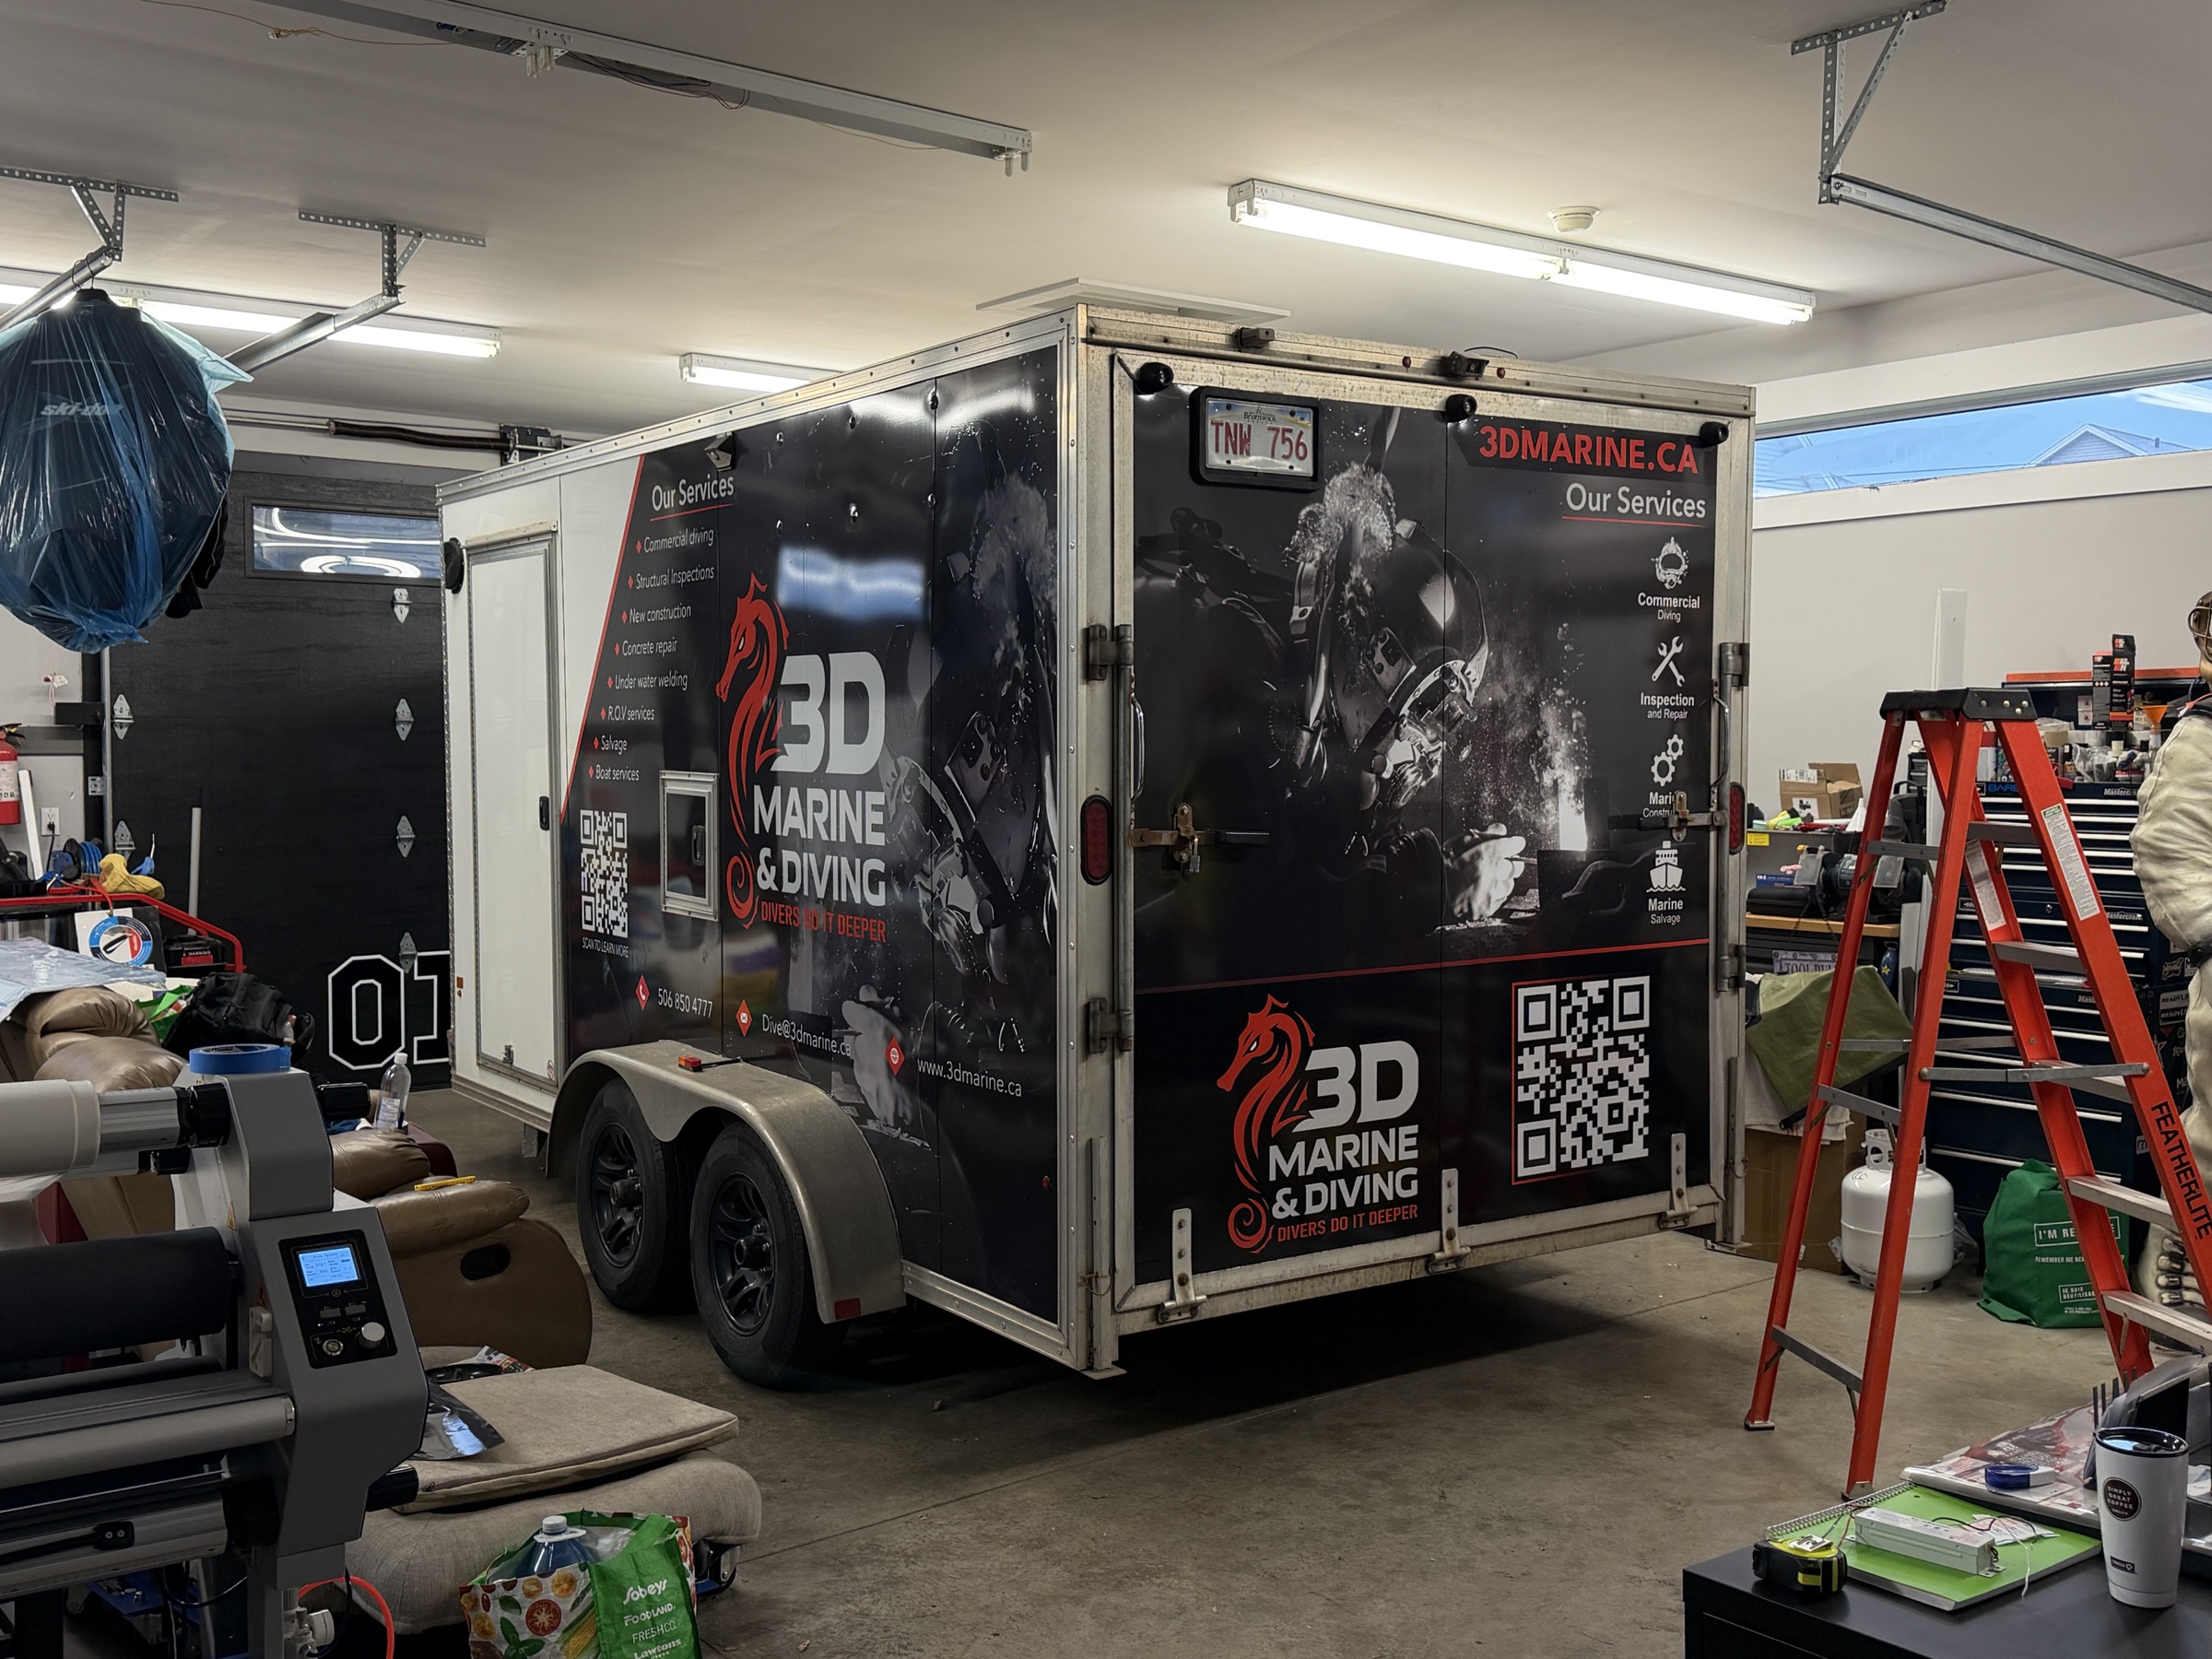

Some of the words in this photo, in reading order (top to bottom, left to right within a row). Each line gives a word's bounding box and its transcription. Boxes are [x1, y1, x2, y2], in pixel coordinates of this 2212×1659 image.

[1243, 411, 1277, 423] Brunswick
[1210, 419, 1252, 457] TNW
[1267, 425, 1308, 461] 756
[1479, 425, 1699, 474] 3DMARINE.CA
[653, 485, 676, 512] Our
[678, 474, 735, 506] Services
[1566, 483, 1610, 515] Our
[1617, 486, 1706, 519] Services
[644, 528, 688, 553] Commercial
[689, 527, 714, 547] diving
[636, 569, 669, 589] Structural
[671, 565, 714, 587] Inspections
[1638, 592, 1700, 609] Commercial
[629, 607, 646, 624] New
[646, 603, 691, 622] construction
[1657, 609, 1681, 623] Diving
[622, 640, 653, 656] Concrete
[655, 637, 677, 657] repair
[615, 674, 636, 689] Under
[637, 676, 657, 688] water
[658, 670, 688, 690] welding
[1641, 692, 1695, 708] Inspection
[608, 706, 627, 721] R.O.V
[627, 705, 654, 721] services
[771, 652, 886, 774] 3D
[1647, 709, 1662, 719] and
[1664, 708, 1688, 721] Repair
[601, 735, 628, 755] Salvage
[595, 764, 611, 781] Boat
[613, 766, 640, 781] services
[1649, 792, 1675, 805] Mari
[753, 784, 886, 846] MARINE
[757, 847, 779, 891] &
[782, 849, 886, 907] DIVING
[1648, 898, 1684, 912] Marine
[761, 900, 800, 927] DIVERS
[804, 908, 818, 931] DO
[823, 911, 834, 933] IT
[837, 913, 887, 943] DEEPER
[1651, 912, 1681, 926] Salvage
[582, 936, 594, 949] SCAN
[594, 939, 601, 951] TO
[601, 941, 615, 955] LEARN
[615, 945, 629, 958] MORE
[657, 988, 673, 1008] 506
[675, 993, 690, 1013] 850
[692, 997, 712, 1018] 4777
[762, 1014, 853, 1058] Dive@3dmarine.ca
[917, 1058, 1022, 1098] www.3dmarine.ca
[1292, 1041, 1418, 1133] 3D
[1269, 1124, 1418, 1181] MARINE
[2151, 1100, 2212, 1240] FEATHERLITE
[1272, 1187, 1300, 1219] &
[1304, 1167, 1418, 1215] DIVING
[1277, 1219, 1325, 1241] DIVERS
[1331, 1216, 1348, 1233] DO
[1353, 1212, 1366, 1228] IT
[1369, 1205, 1418, 1226] DEEPER
[2039, 1229, 2057, 1240] I'M
[2107, 1486, 2131, 1496] SIMPLY
[2108, 1492, 2131, 1502] GREAT
[2107, 1498, 2134, 1510] COFFEE
[623, 1579, 667, 1606] Sobeys
[634, 1639, 682, 1659] Lawtons
